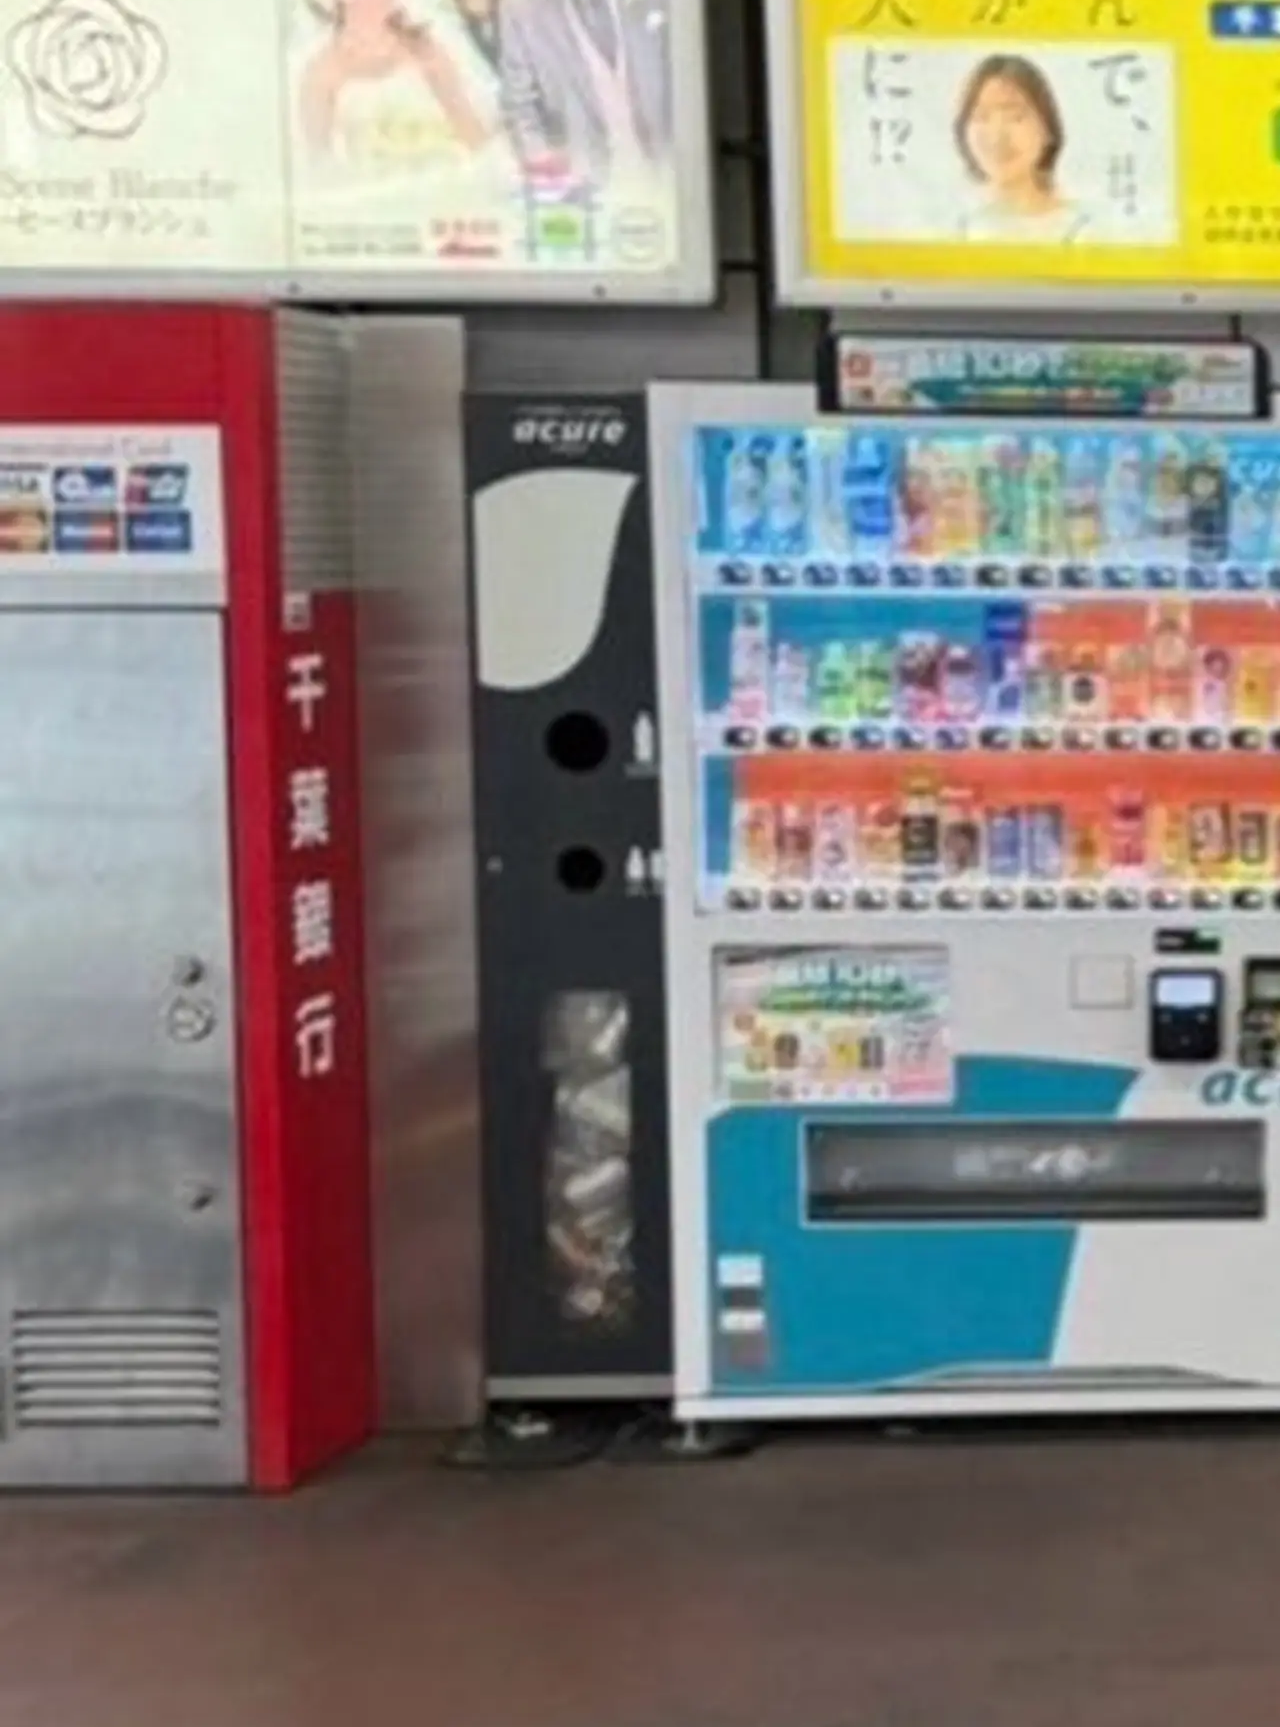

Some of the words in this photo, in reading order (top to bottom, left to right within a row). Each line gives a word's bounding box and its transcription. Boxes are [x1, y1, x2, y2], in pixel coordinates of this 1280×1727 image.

[513, 418, 627, 447] acure
[285, 653, 337, 1079] 千葉銀行
